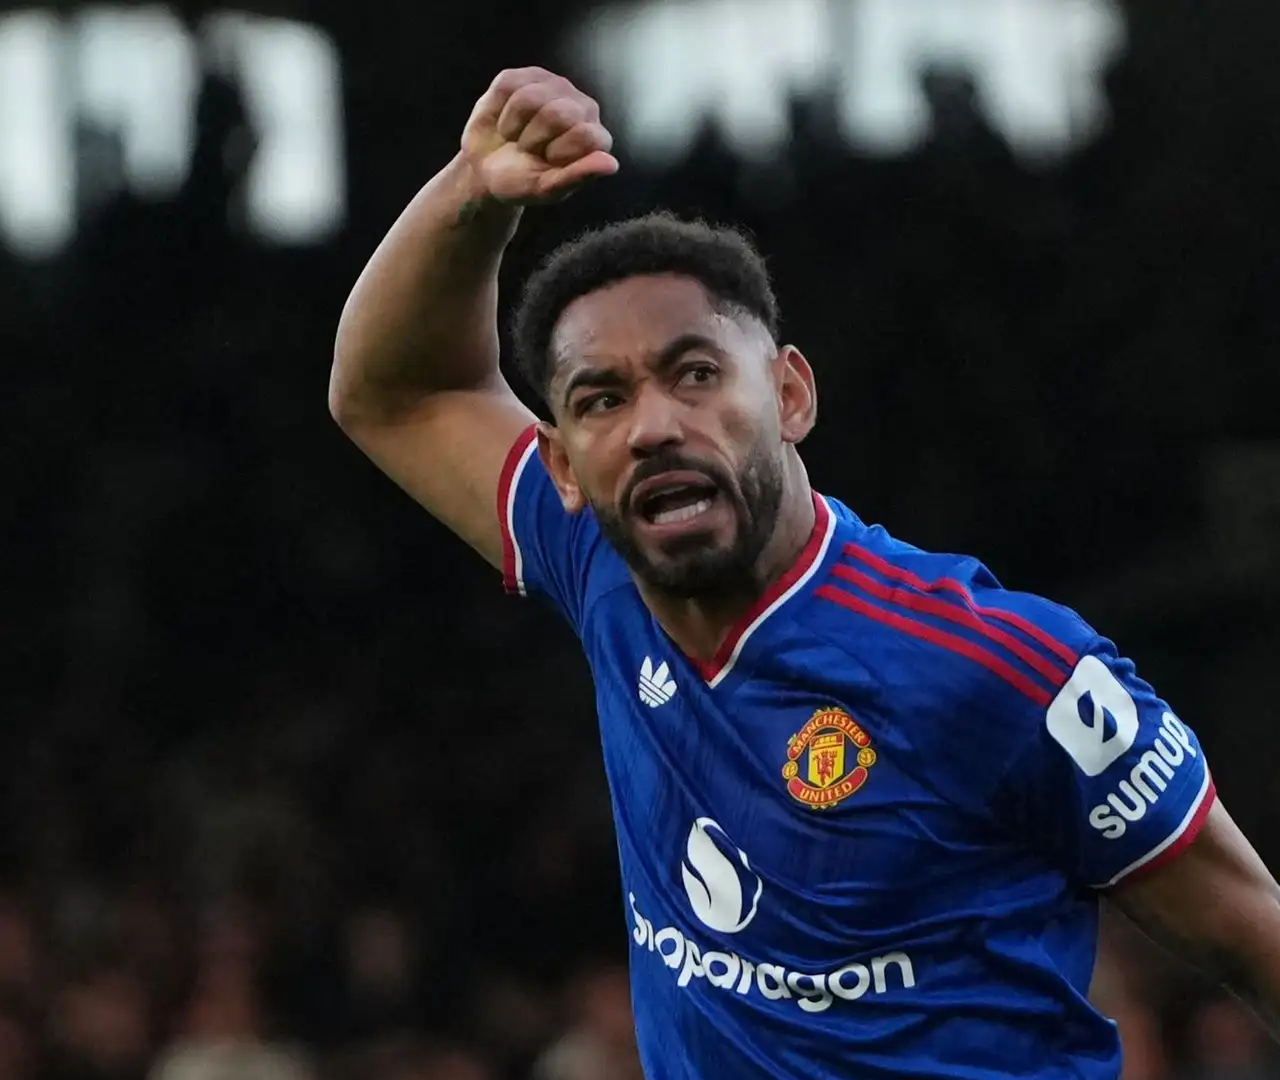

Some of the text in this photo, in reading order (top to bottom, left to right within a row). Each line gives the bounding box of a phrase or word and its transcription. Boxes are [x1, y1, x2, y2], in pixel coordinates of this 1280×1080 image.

[793, 714, 866, 752] MANCHESTER
[800, 781, 852, 802] UNITED
[1089, 711, 1197, 839] sumup
